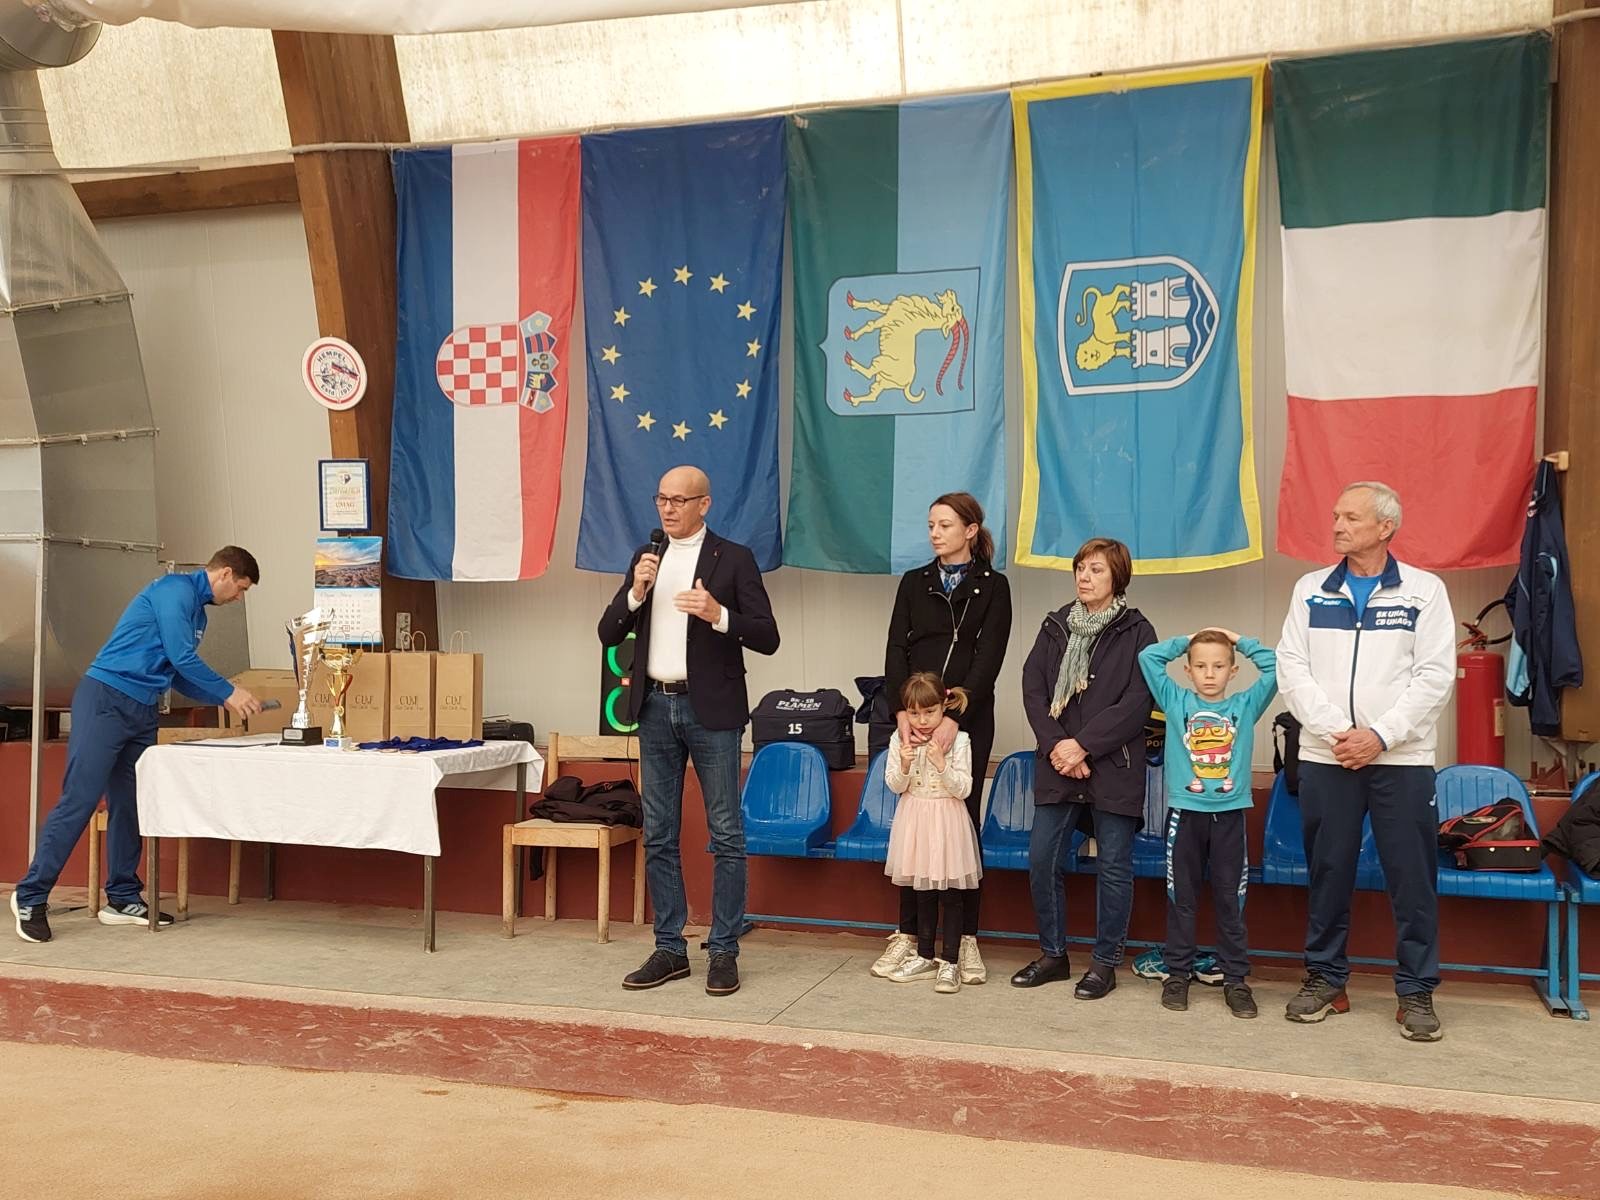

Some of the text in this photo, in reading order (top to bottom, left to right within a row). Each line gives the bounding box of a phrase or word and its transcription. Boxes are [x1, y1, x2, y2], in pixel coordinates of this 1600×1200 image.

[317, 351, 347, 363] HEMPEL
[777, 700, 822, 709] PLAMEN
[788, 723, 803, 735] 15
